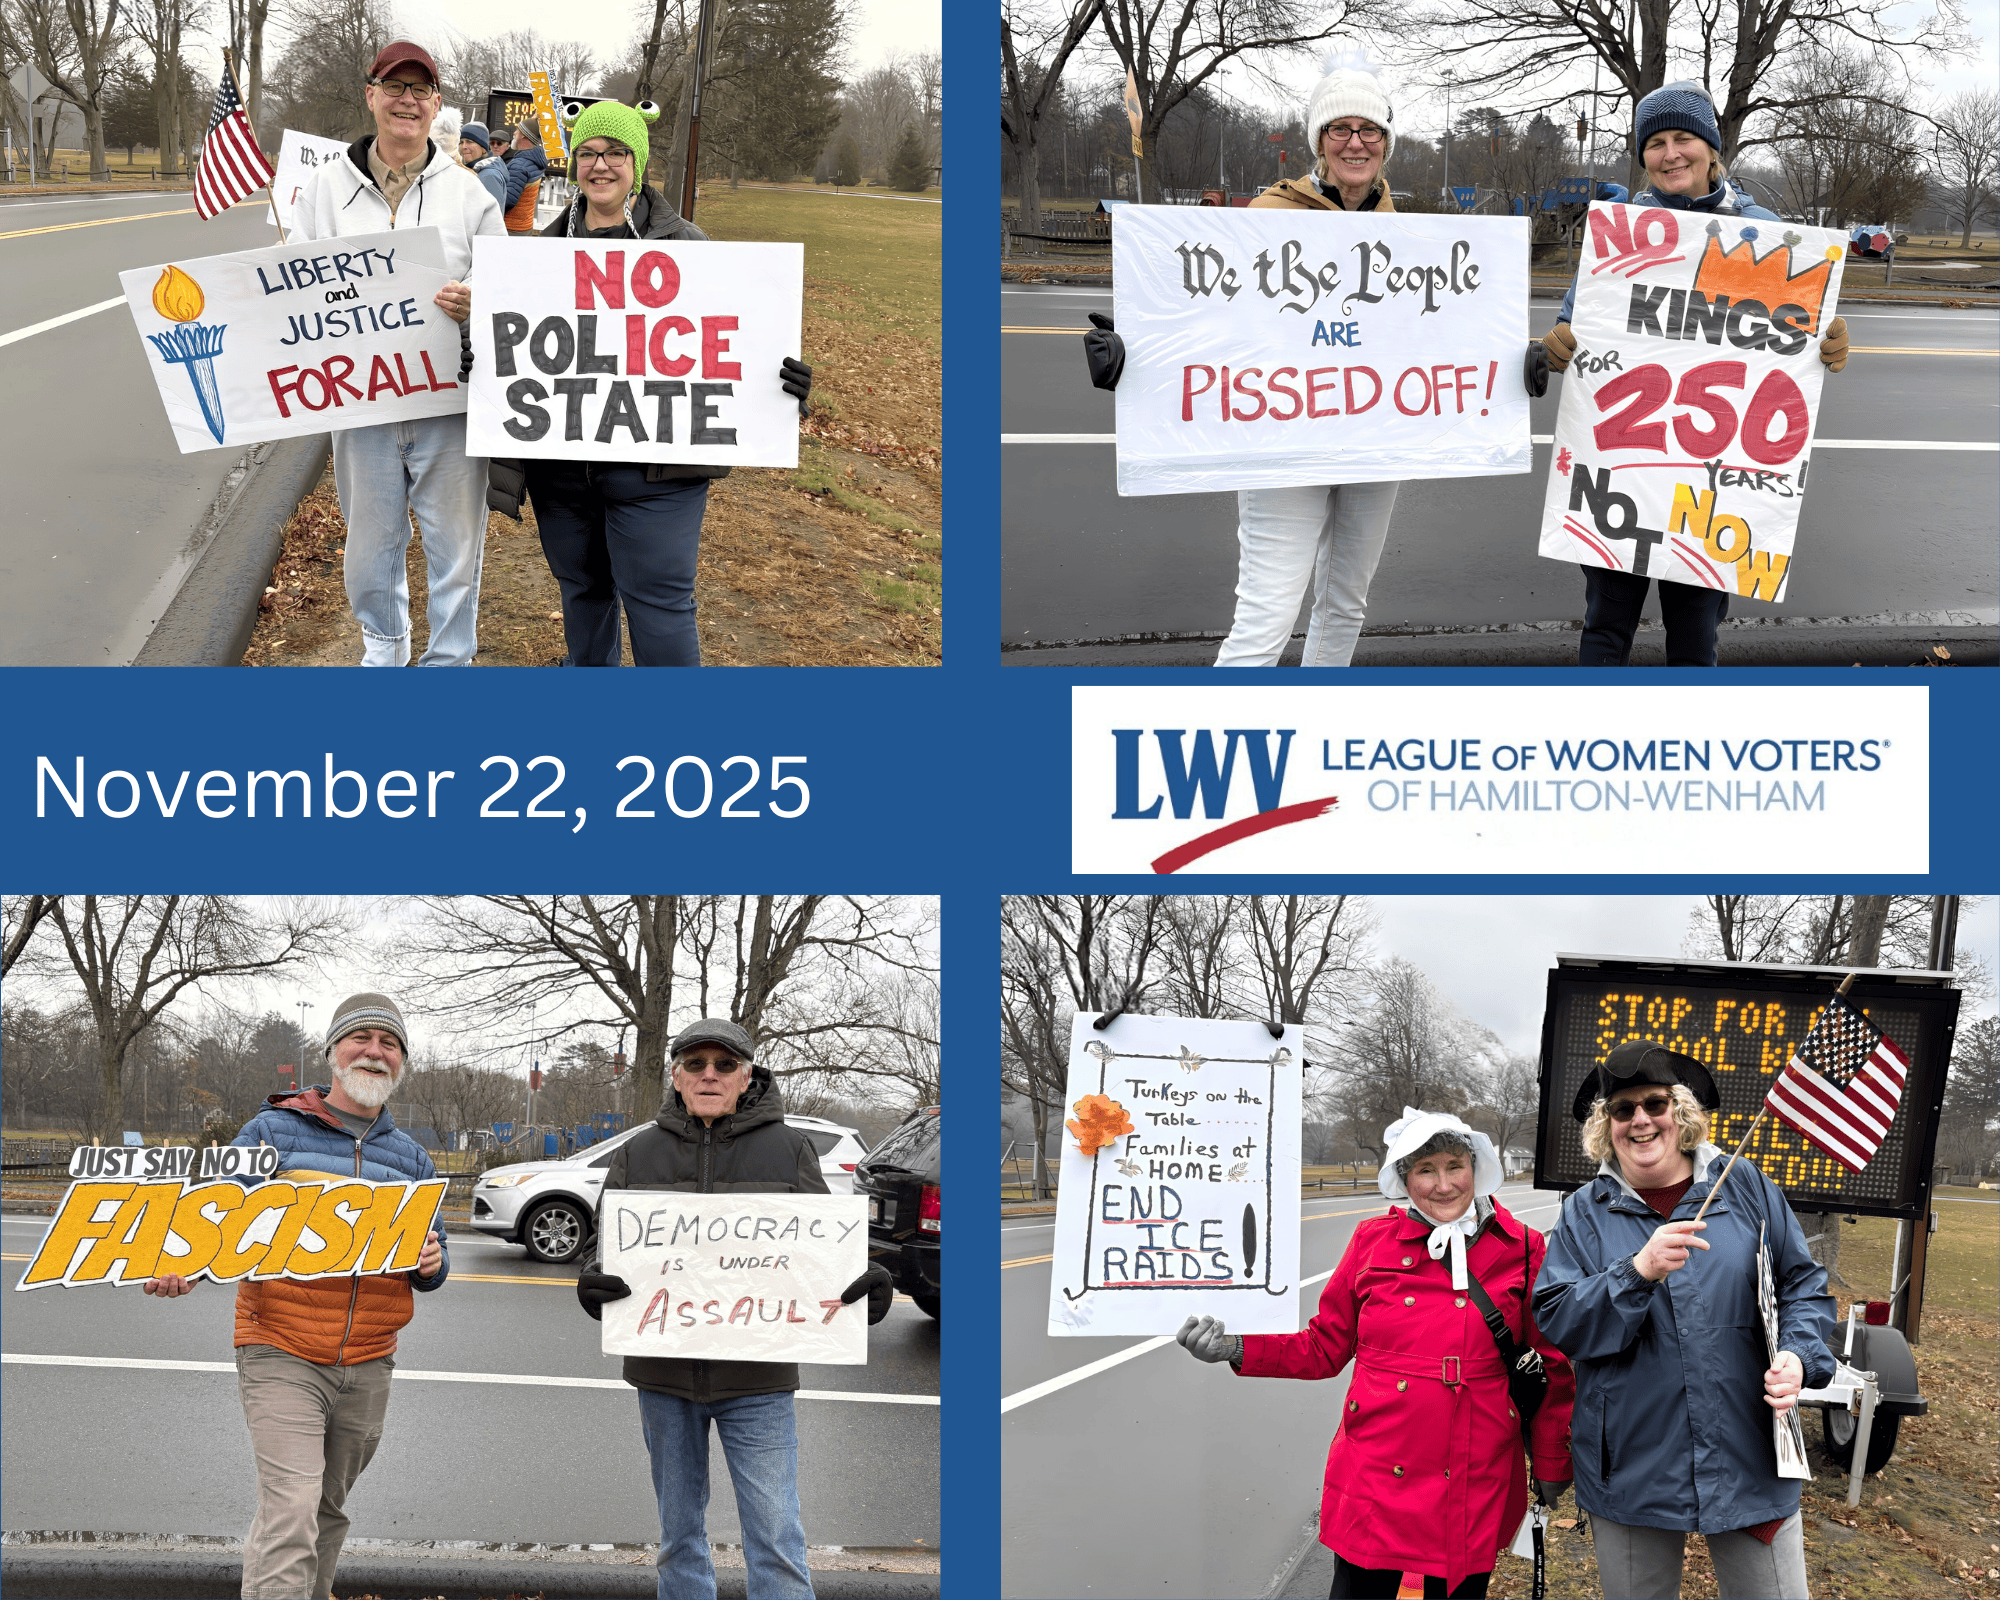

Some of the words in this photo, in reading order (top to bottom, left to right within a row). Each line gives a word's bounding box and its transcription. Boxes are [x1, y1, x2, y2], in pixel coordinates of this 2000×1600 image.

[505, 101, 536, 115] STOP
[300, 145, 319, 168] We
[1587, 203, 1680, 261] NO
[256, 248, 395, 295] LIBERTY
[325, 283, 360, 304] and
[574, 250, 681, 310] NO
[1174, 240, 1243, 302] We
[1252, 239, 1342, 315] the
[1341, 240, 1482, 317] People
[280, 298, 425, 345] JUSTICE
[1311, 319, 1362, 347] ARE
[1626, 283, 1810, 355] KINGS
[492, 311, 742, 381] POLICE
[1573, 349, 1624, 379] FOR
[267, 355, 364, 418] FOR
[367, 350, 458, 401] ALL
[1181, 364, 1383, 422] PISSED
[1393, 360, 1499, 417] OFF!
[502, 377, 738, 446] STATE
[1593, 360, 1809, 466] 250
[1703, 458, 1809, 498] YEARS!
[1667, 482, 1792, 603] NOW
[1598, 993, 1692, 1030] STOP
[1713, 1000, 1786, 1036] FOR
[1206, 1090, 1227, 1102] on
[1233, 1088, 1262, 1105] the
[74, 1147, 140, 1176] JUST
[143, 1147, 195, 1176] SAY
[204, 1147, 240, 1174] NO
[246, 1147, 277, 1175] TO
[1125, 1135, 1219, 1159] Families
[1233, 1136, 1257, 1160] at
[1149, 1159, 1222, 1183] HOME
[1102, 1184, 1183, 1221] END
[23, 1181, 446, 1285] FASCISM
[617, 1206, 860, 1252] DEMOCRACY
[1136, 1219, 1223, 1251] ICE
[660, 1257, 684, 1275] IS
[719, 1255, 790, 1271] UNDER
[1104, 1247, 1233, 1281] RAIDS
[637, 1287, 850, 1336] ASSAULT
